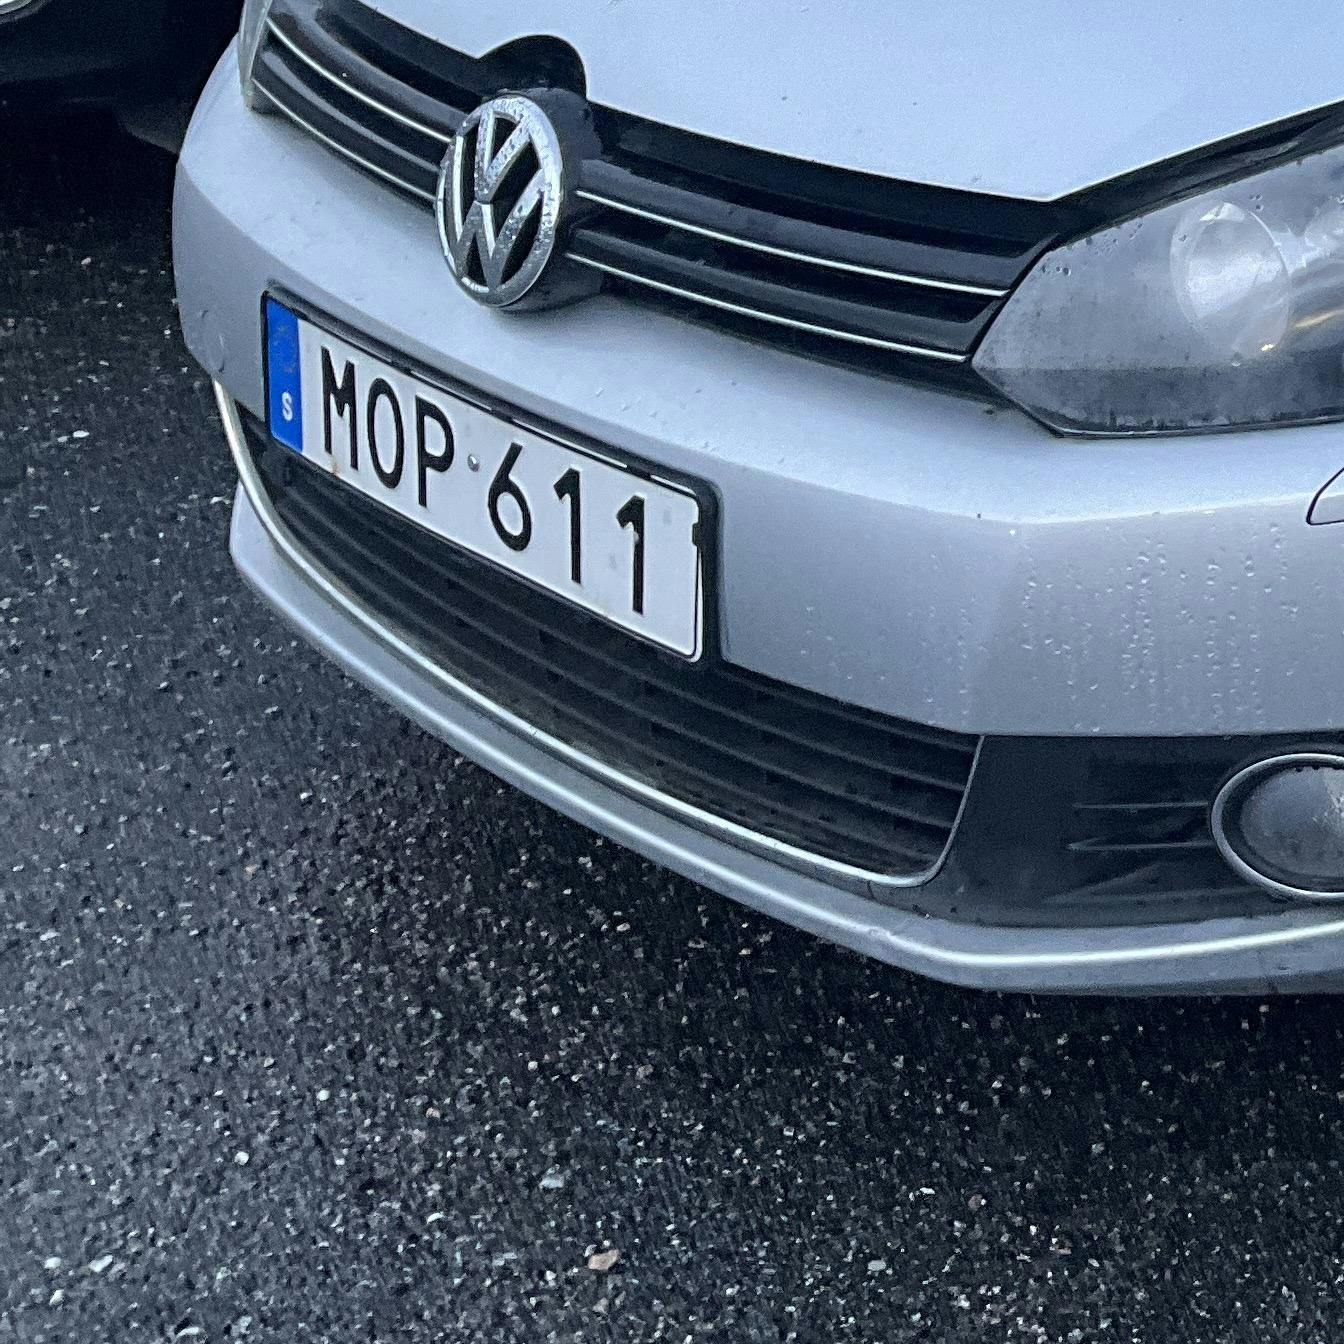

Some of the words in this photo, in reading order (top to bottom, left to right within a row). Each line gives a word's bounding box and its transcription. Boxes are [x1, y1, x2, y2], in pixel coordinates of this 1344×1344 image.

[281, 391, 293, 421] S
[321, 346, 455, 507] MOP
[488, 442, 645, 615] 611
